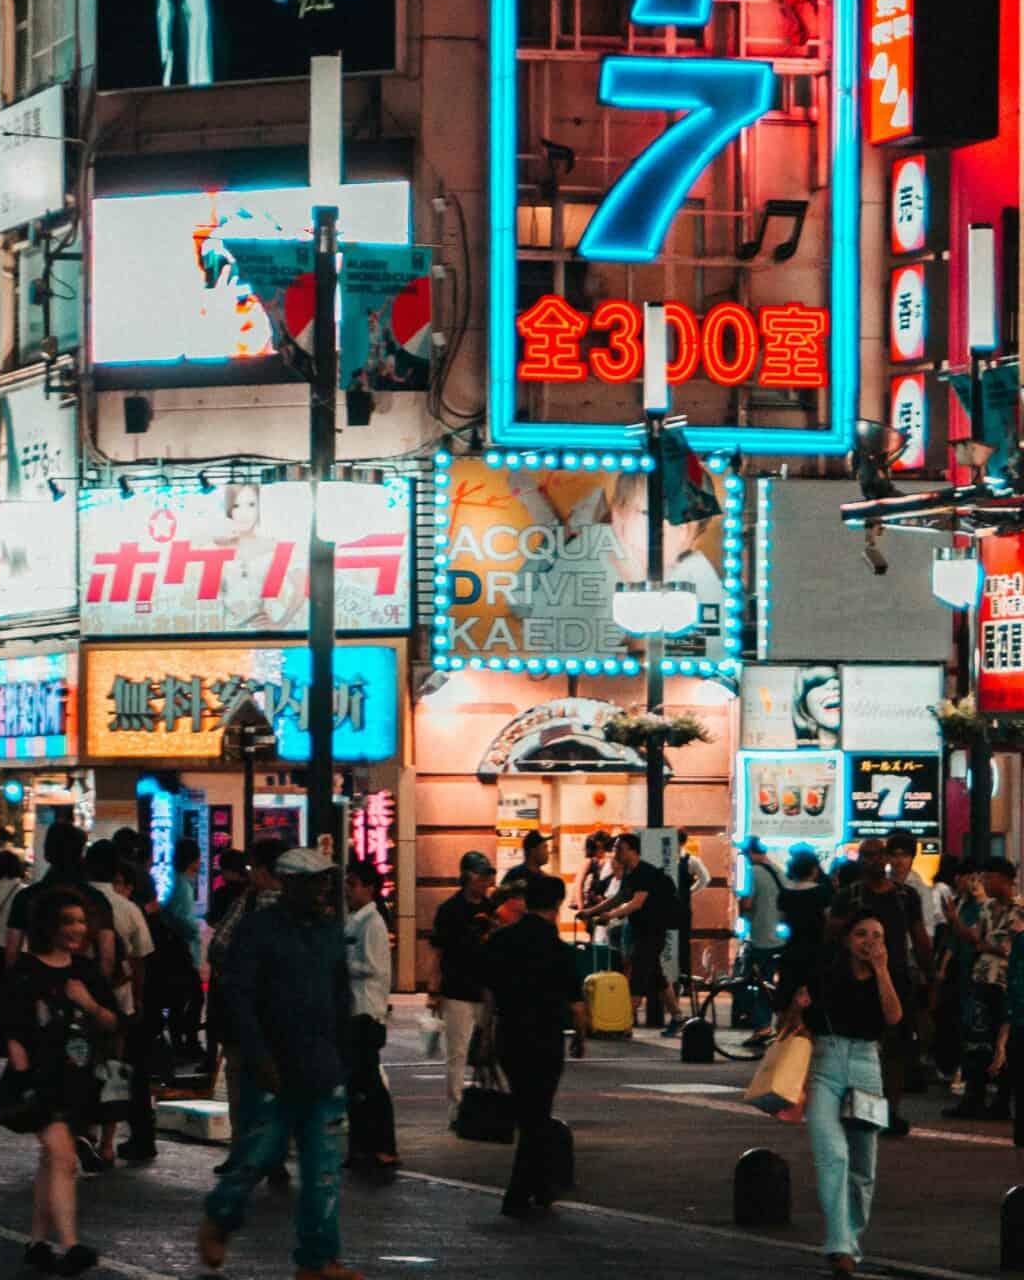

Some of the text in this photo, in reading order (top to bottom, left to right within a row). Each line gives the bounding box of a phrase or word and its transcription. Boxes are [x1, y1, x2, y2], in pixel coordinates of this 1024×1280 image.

[448, 523, 631, 562] ACQUA
[448, 571, 608, 608] DRIVE
[448, 616, 629, 655] KAEDE
[871, 774, 913, 817] 7
